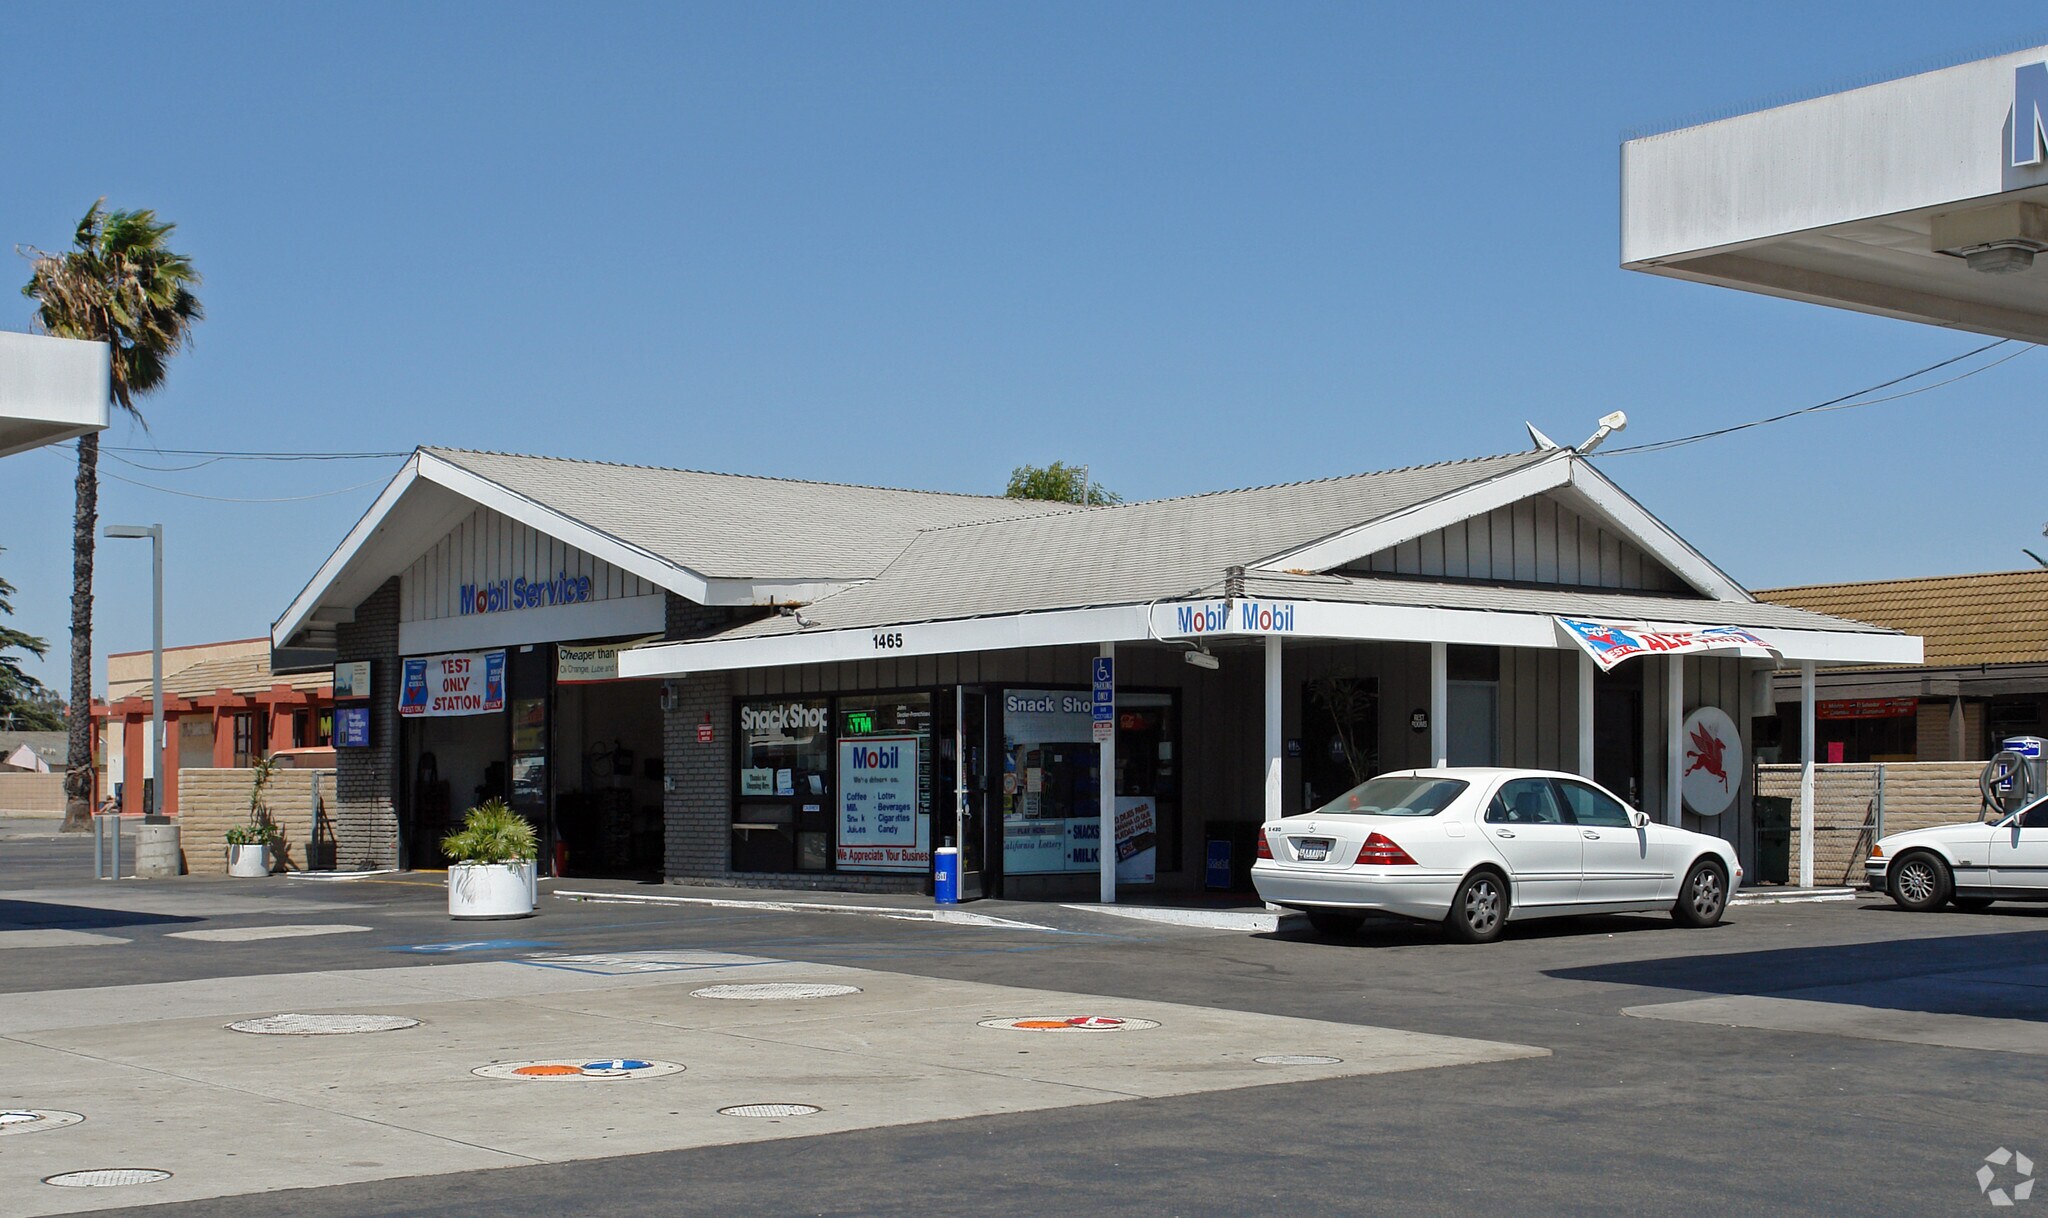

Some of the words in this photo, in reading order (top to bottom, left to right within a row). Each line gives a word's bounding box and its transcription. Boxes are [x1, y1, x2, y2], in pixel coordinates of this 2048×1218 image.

[460, 580, 511, 616] Mobil
[513, 570, 590, 610] Service
[1178, 603, 1227, 633] Mobil
[1242, 603, 1294, 632] Mobil
[872, 633, 903, 650] 1465
[560, 649, 596, 663] Cheaper
[597, 647, 615, 660] than
[441, 659, 471, 675] TEST
[442, 677, 471, 693] ONLY
[1094, 681, 1112, 690] PARKING
[432, 695, 481, 711] STATION
[1097, 692, 1109, 701] ONLY
[1007, 695, 1055, 713] Snack
[1062, 696, 1093, 716] Sho
[741, 705, 789, 731] Snack
[789, 703, 828, 734] Shop
[853, 746, 899, 769] Mobil
[846, 792, 868, 801] Coffee
[877, 802, 911, 813] Beverages
[877, 824, 899, 835] Candy
[1073, 824, 1100, 840] SNACKS
[1038, 839, 1062, 850] Lottery
[837, 849, 848, 860] We
[848, 849, 884, 864] Appreciate
[886, 849, 901, 861] Your
[901, 848, 930, 862] Busines
[1073, 848, 1099, 863] MILK
